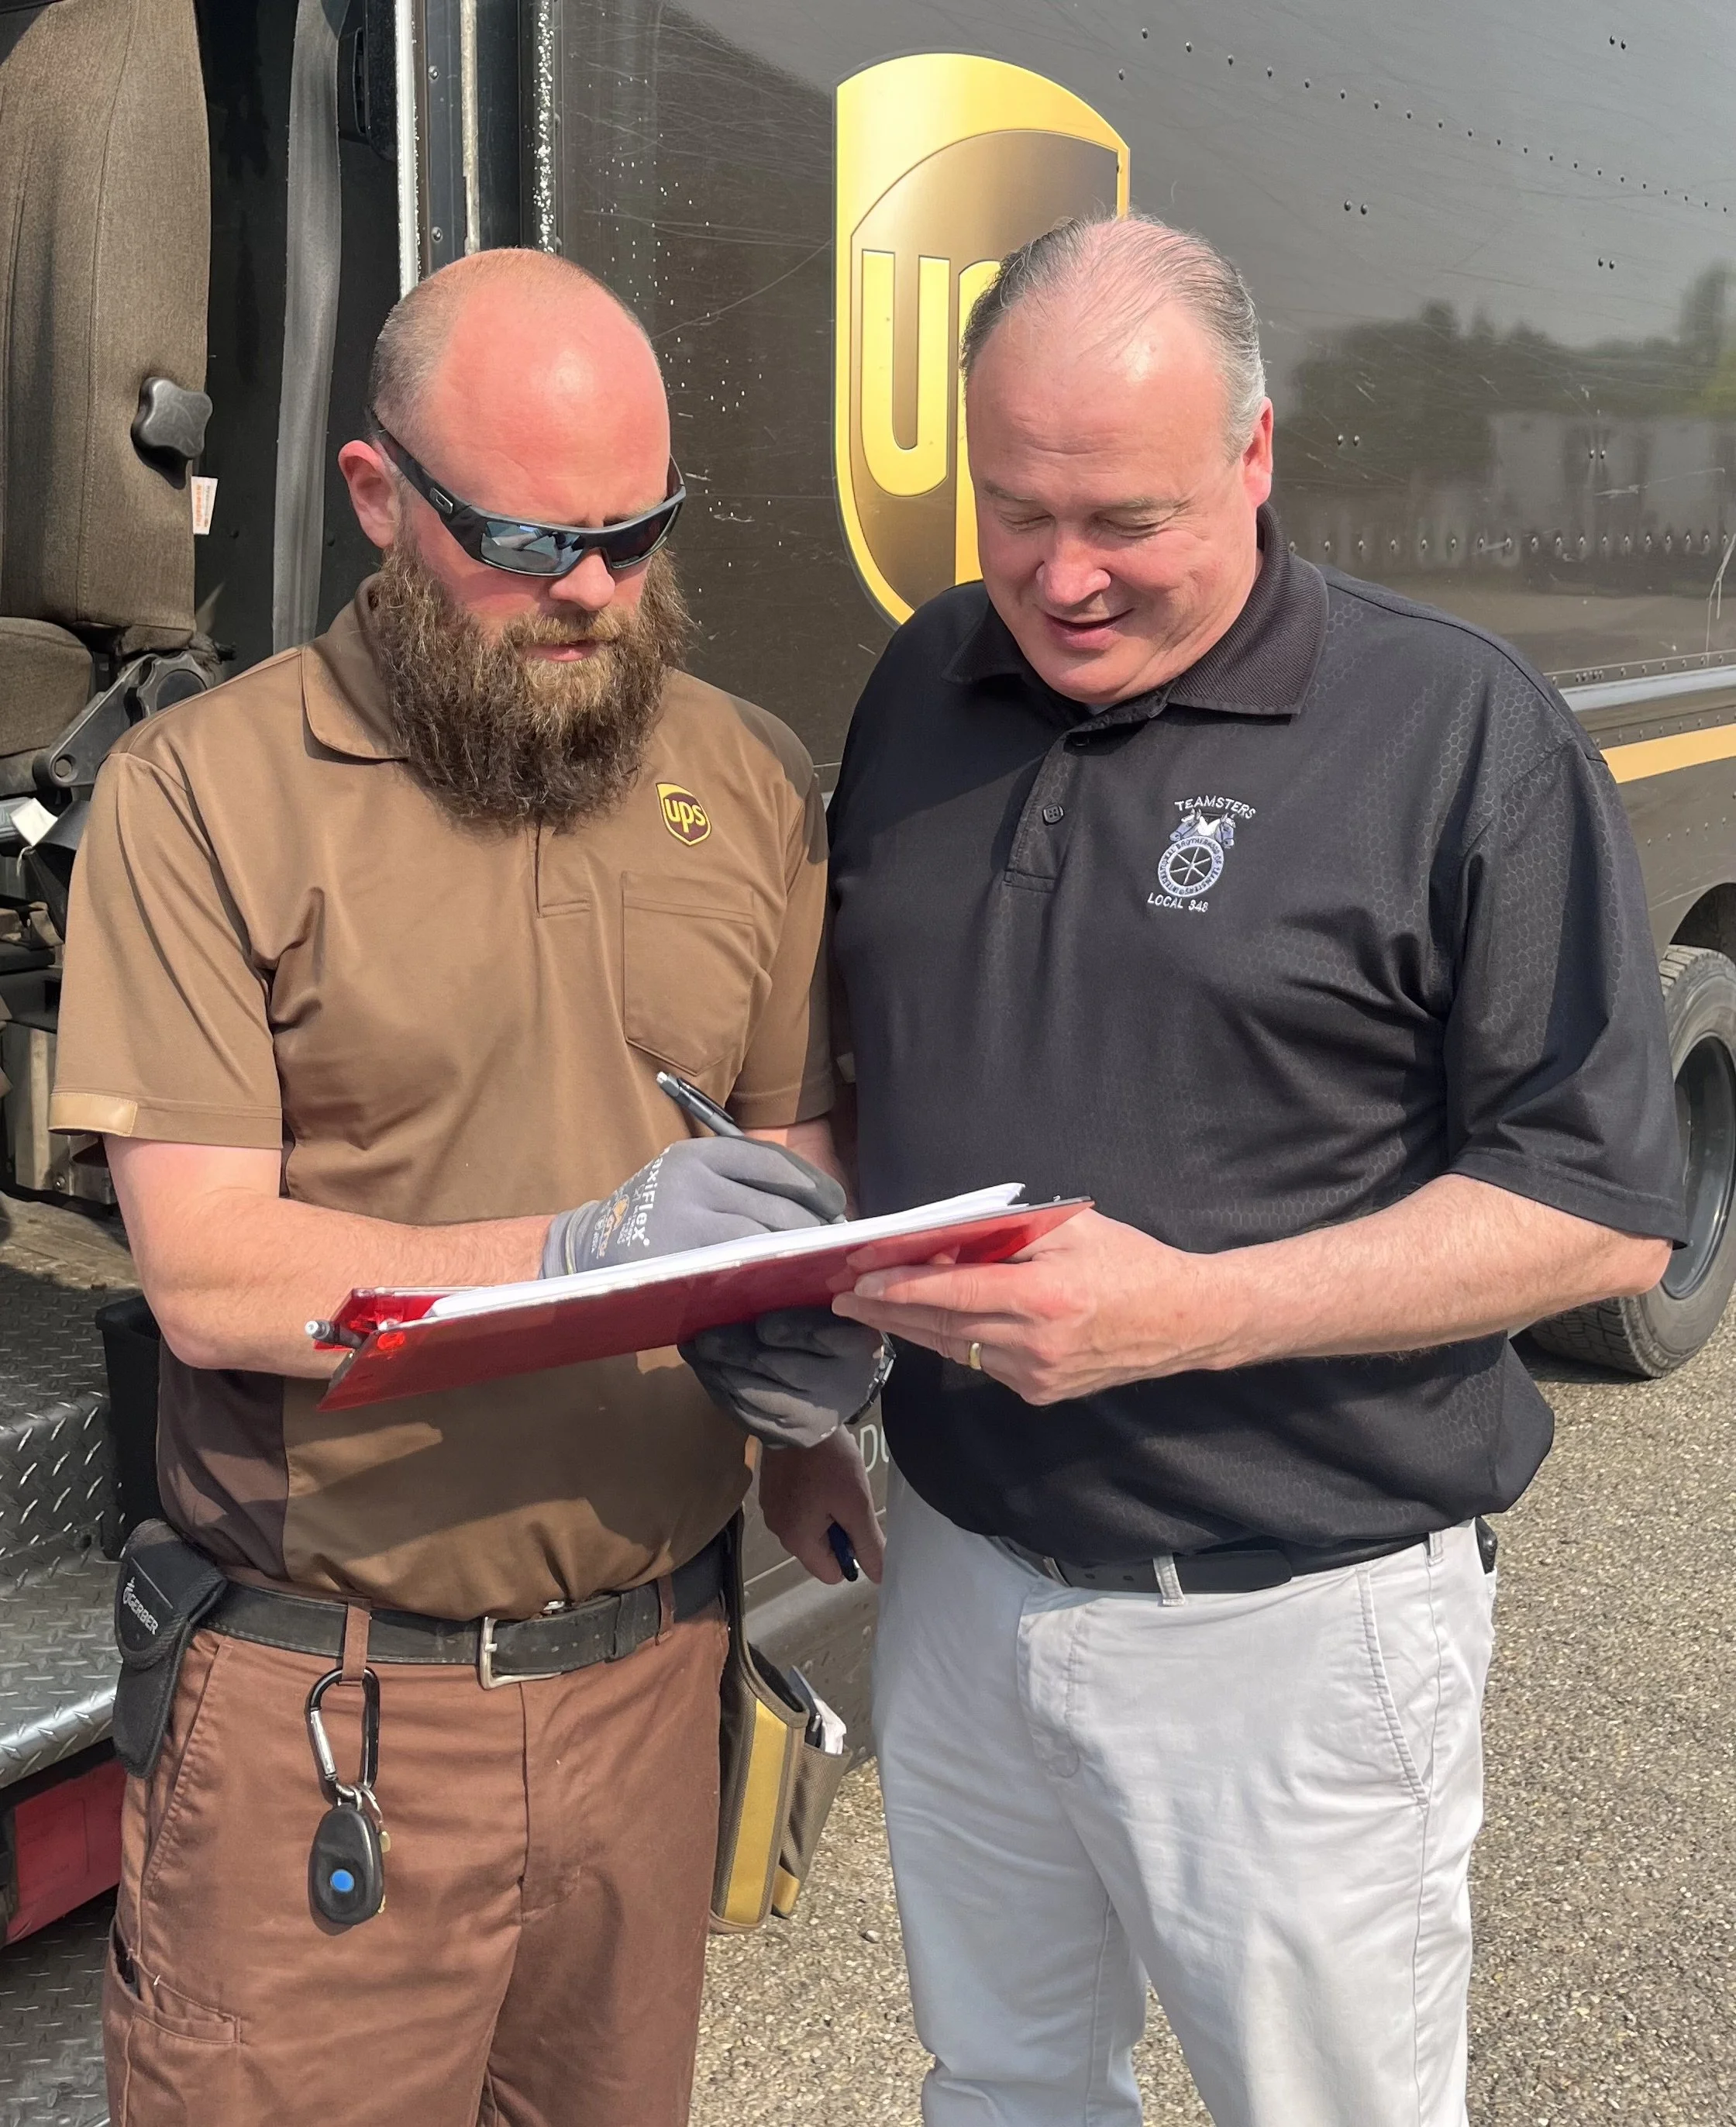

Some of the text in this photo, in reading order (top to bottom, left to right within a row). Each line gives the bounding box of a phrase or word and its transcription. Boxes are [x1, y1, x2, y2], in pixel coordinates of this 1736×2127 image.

[664, 798, 706, 833] ups
[1174, 795, 1256, 819] TEAMSTERS
[1147, 892, 1209, 913] LOCAL 348
[632, 1149, 668, 1241] axiFlex
[128, 1593, 159, 1635] GERBER
